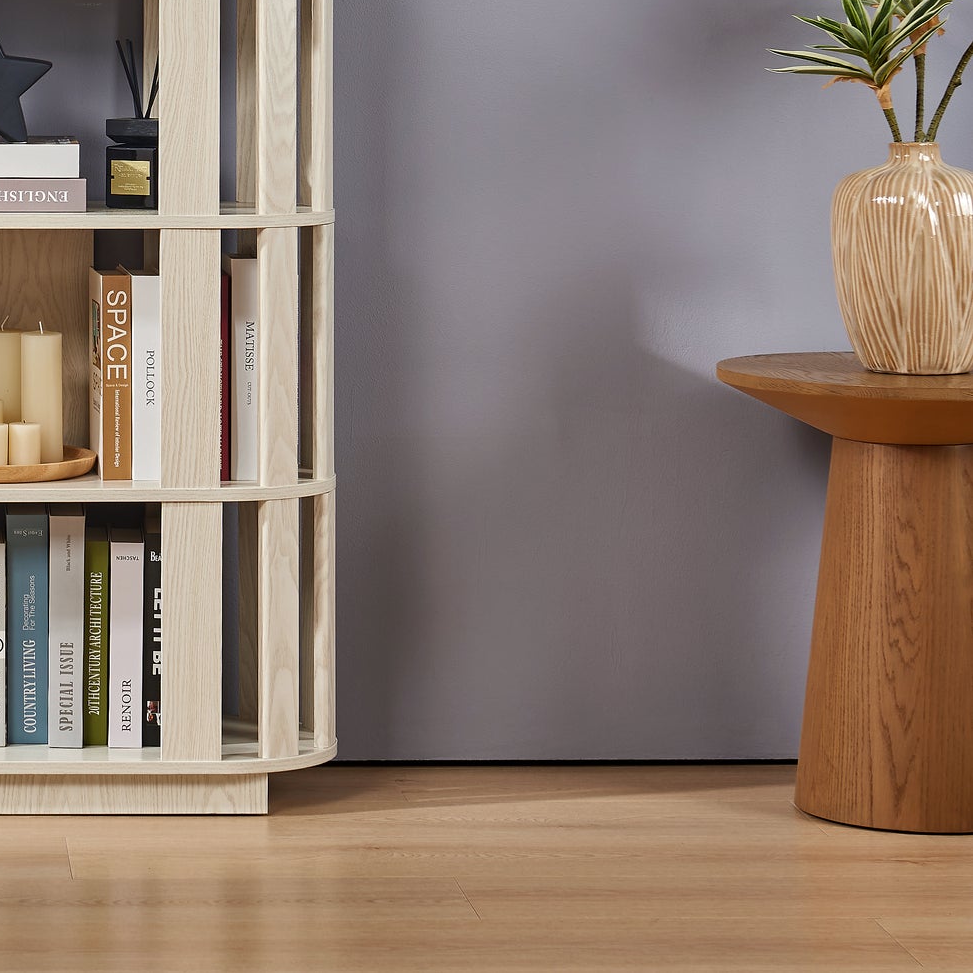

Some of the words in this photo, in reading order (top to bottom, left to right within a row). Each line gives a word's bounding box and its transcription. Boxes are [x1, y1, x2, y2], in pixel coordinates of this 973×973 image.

[106, 290, 128, 380] SPACE
[245, 321, 255, 372] MATISSE
[146, 350, 155, 406] POLLOCK
[23, 639, 36, 678] LIVING
[60, 642, 74, 676] ISSUE
[24, 680, 37, 733] COUNTRY
[59, 681, 73, 732] SPECIAL
[122, 679, 132, 732] RENOIR
